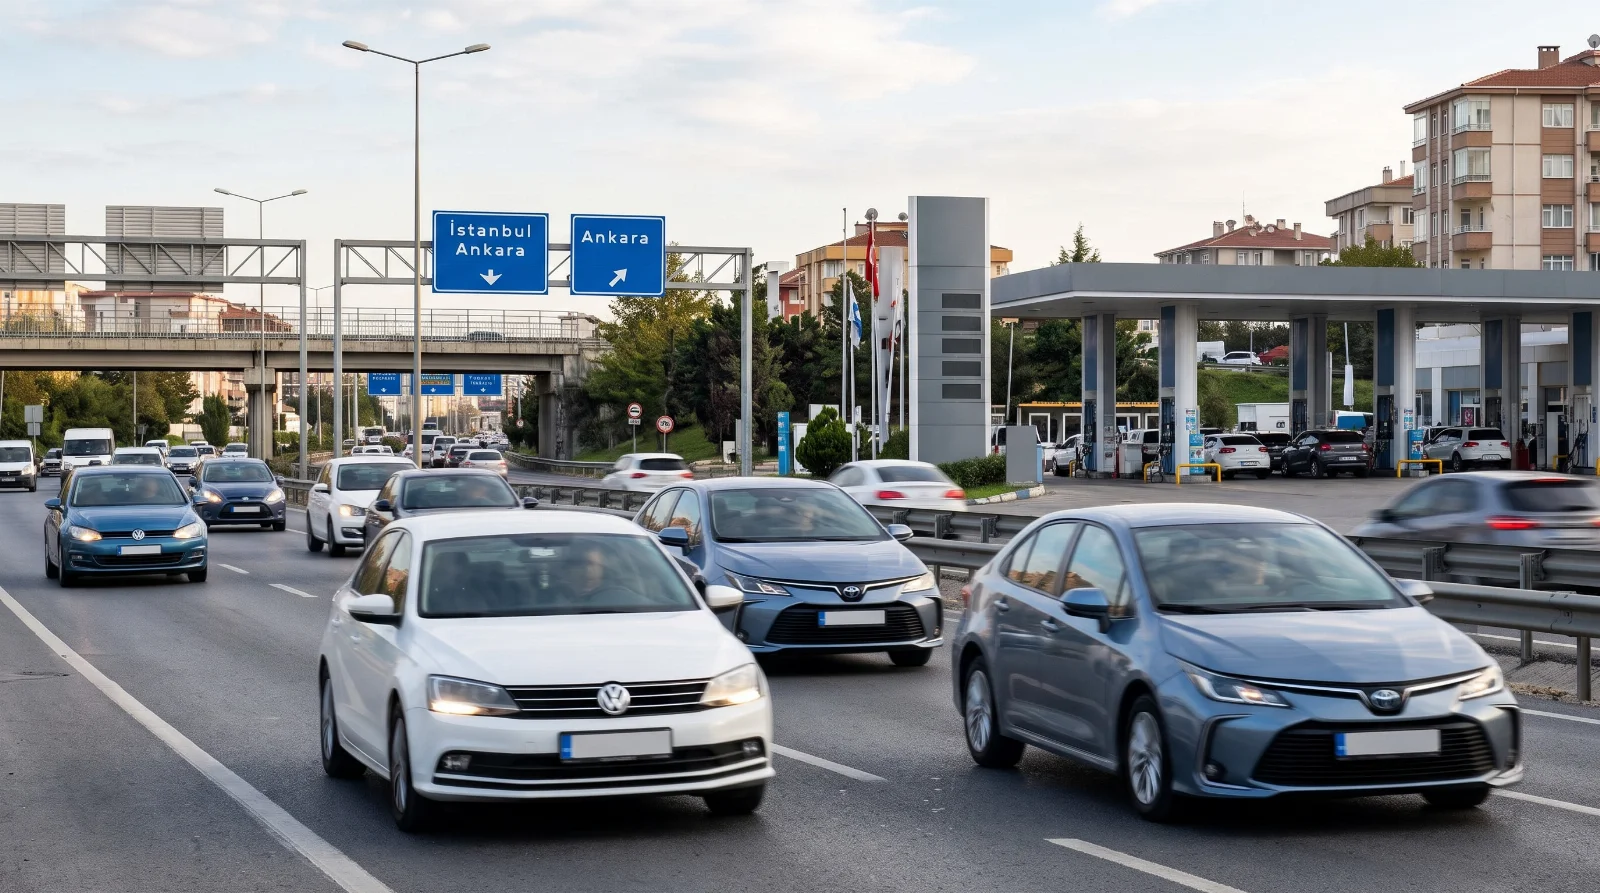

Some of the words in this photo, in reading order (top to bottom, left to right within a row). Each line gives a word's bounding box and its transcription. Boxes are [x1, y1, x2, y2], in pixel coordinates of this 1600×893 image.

[449, 219, 532, 238] İstanbul
[581, 230, 649, 245] Ankara
[455, 242, 525, 257] Ankara
[598, 685, 631, 714] VW
